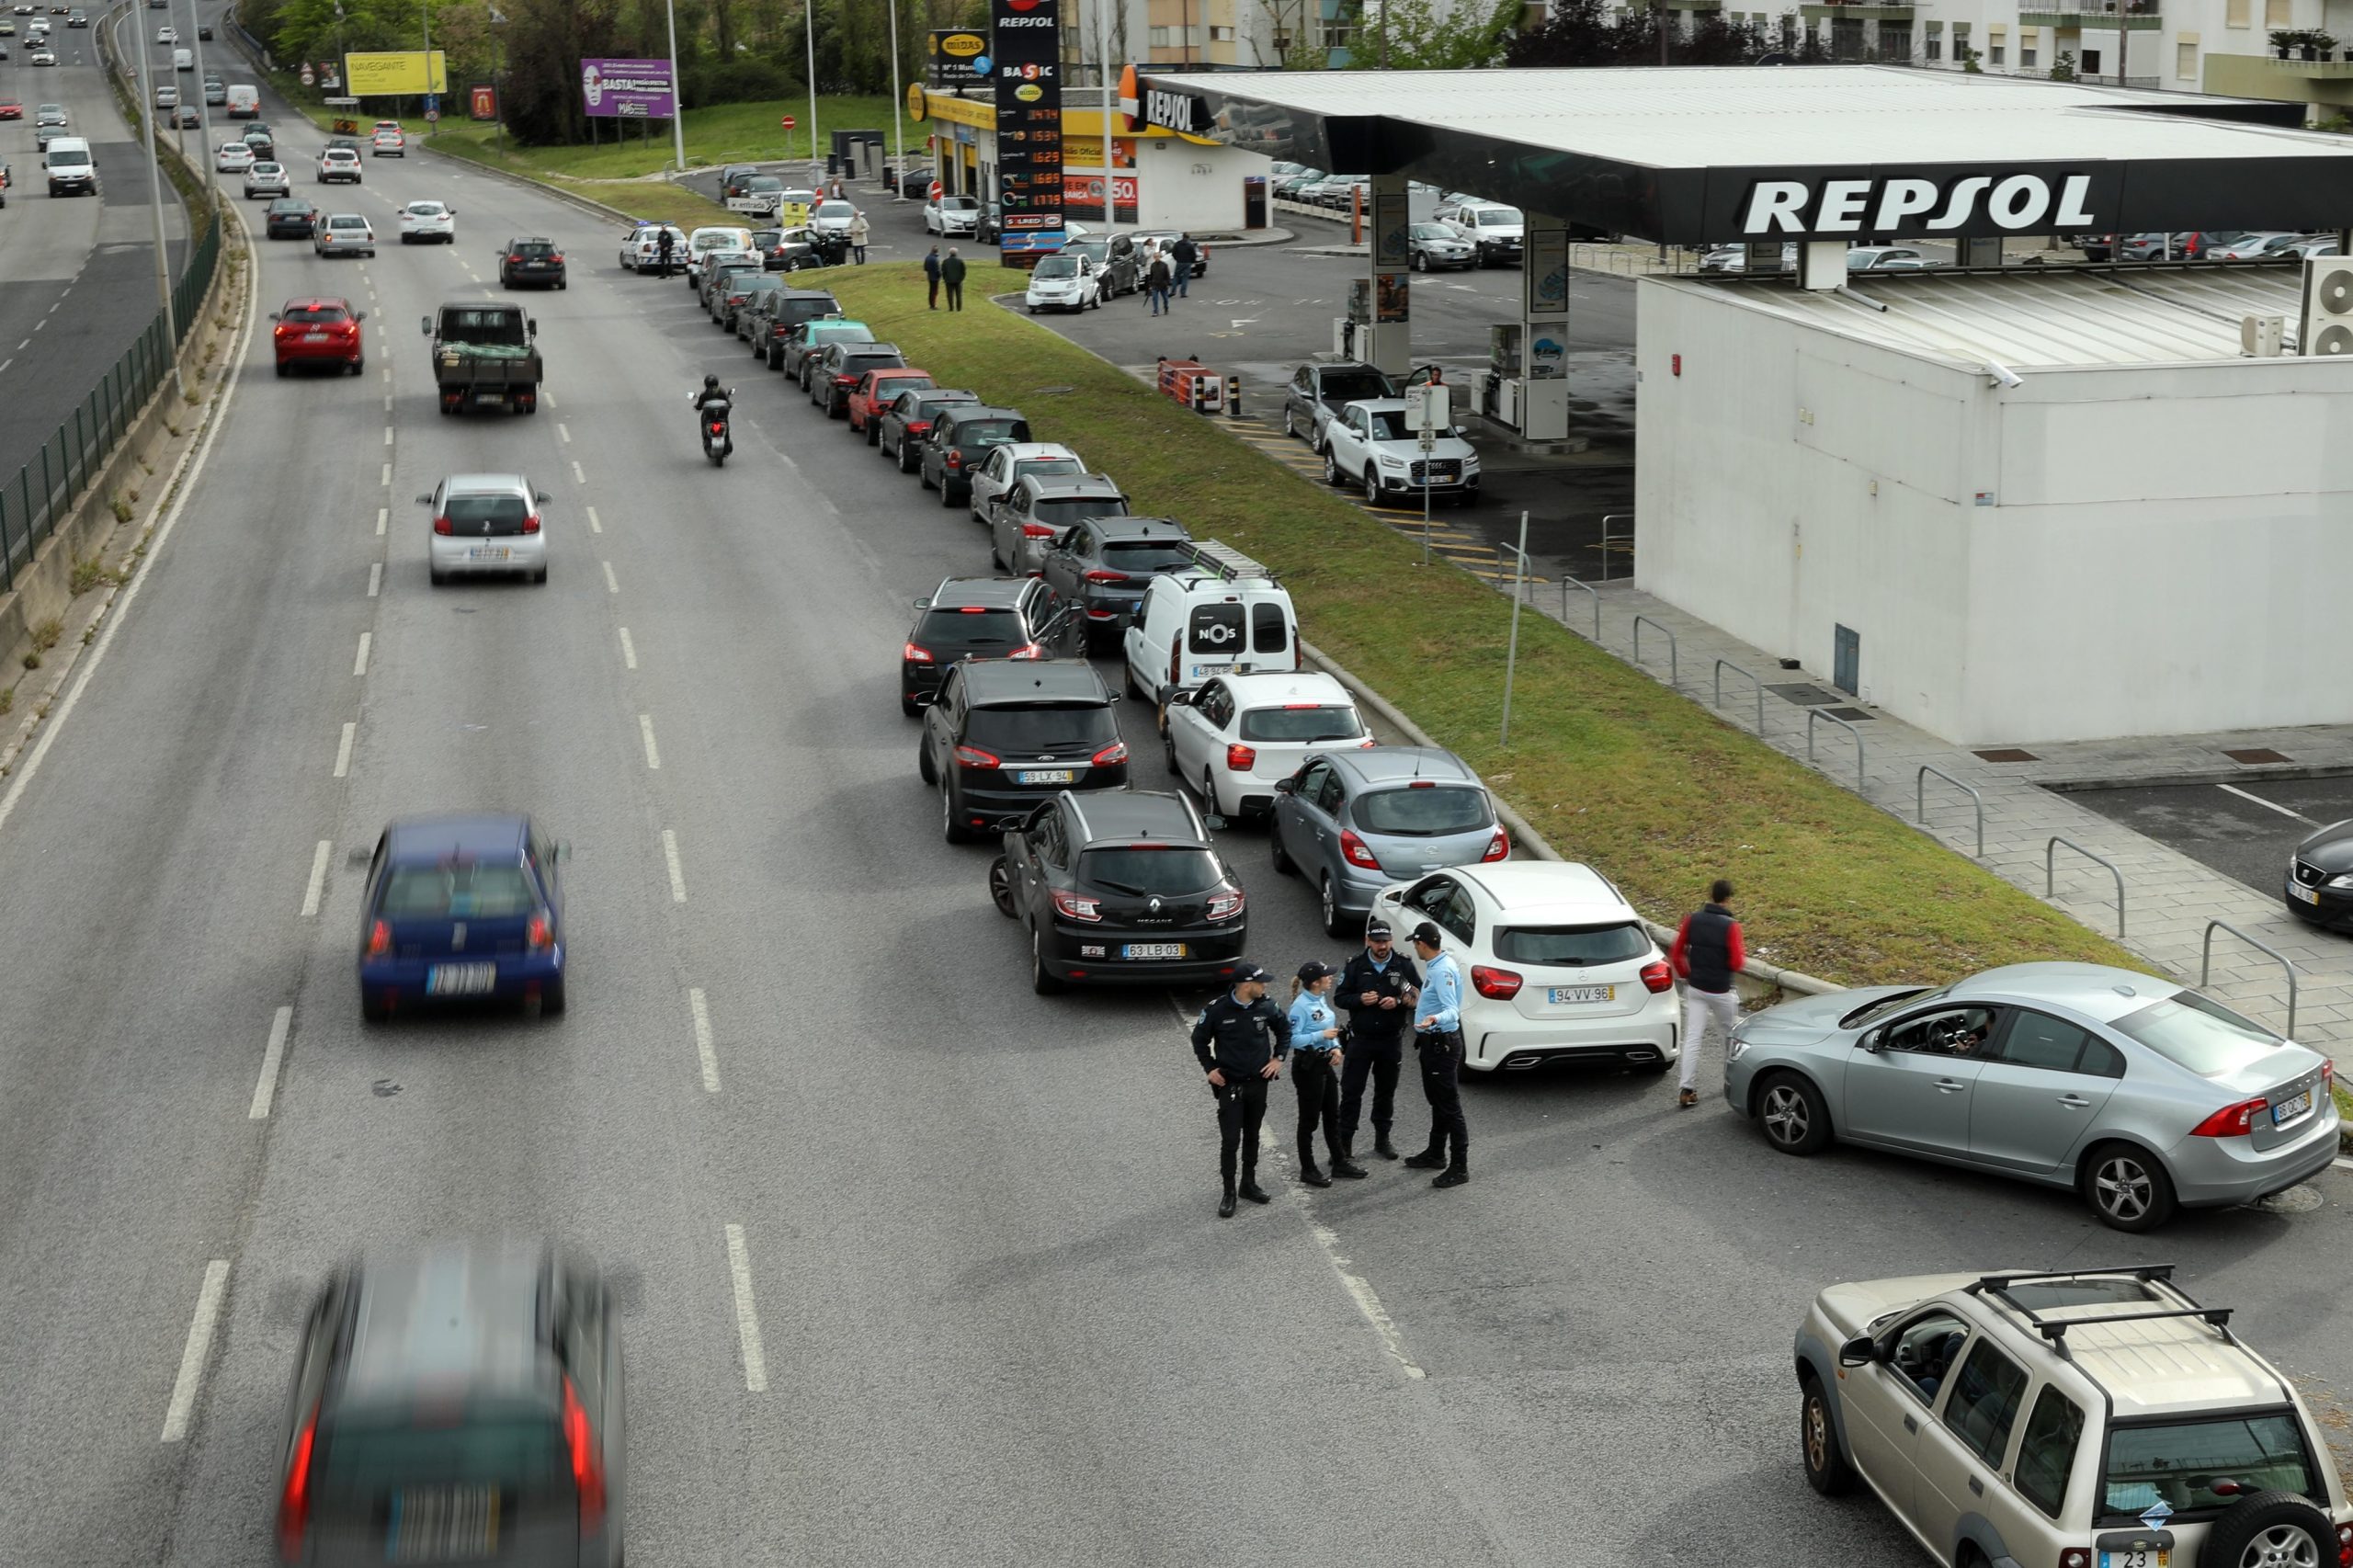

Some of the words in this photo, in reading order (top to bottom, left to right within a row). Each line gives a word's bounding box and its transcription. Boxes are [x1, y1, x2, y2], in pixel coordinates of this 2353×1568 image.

[999, 17, 1054, 27] REPSOL
[1003, 64, 1052, 79] BASIC
[1146, 90, 1193, 131] REPSOL
[739, 201, 766, 210] entrada
[1743, 174, 2095, 234] REPSOL
[1199, 623, 1236, 643] NOS
[2124, 1551, 2146, 1568] 23
